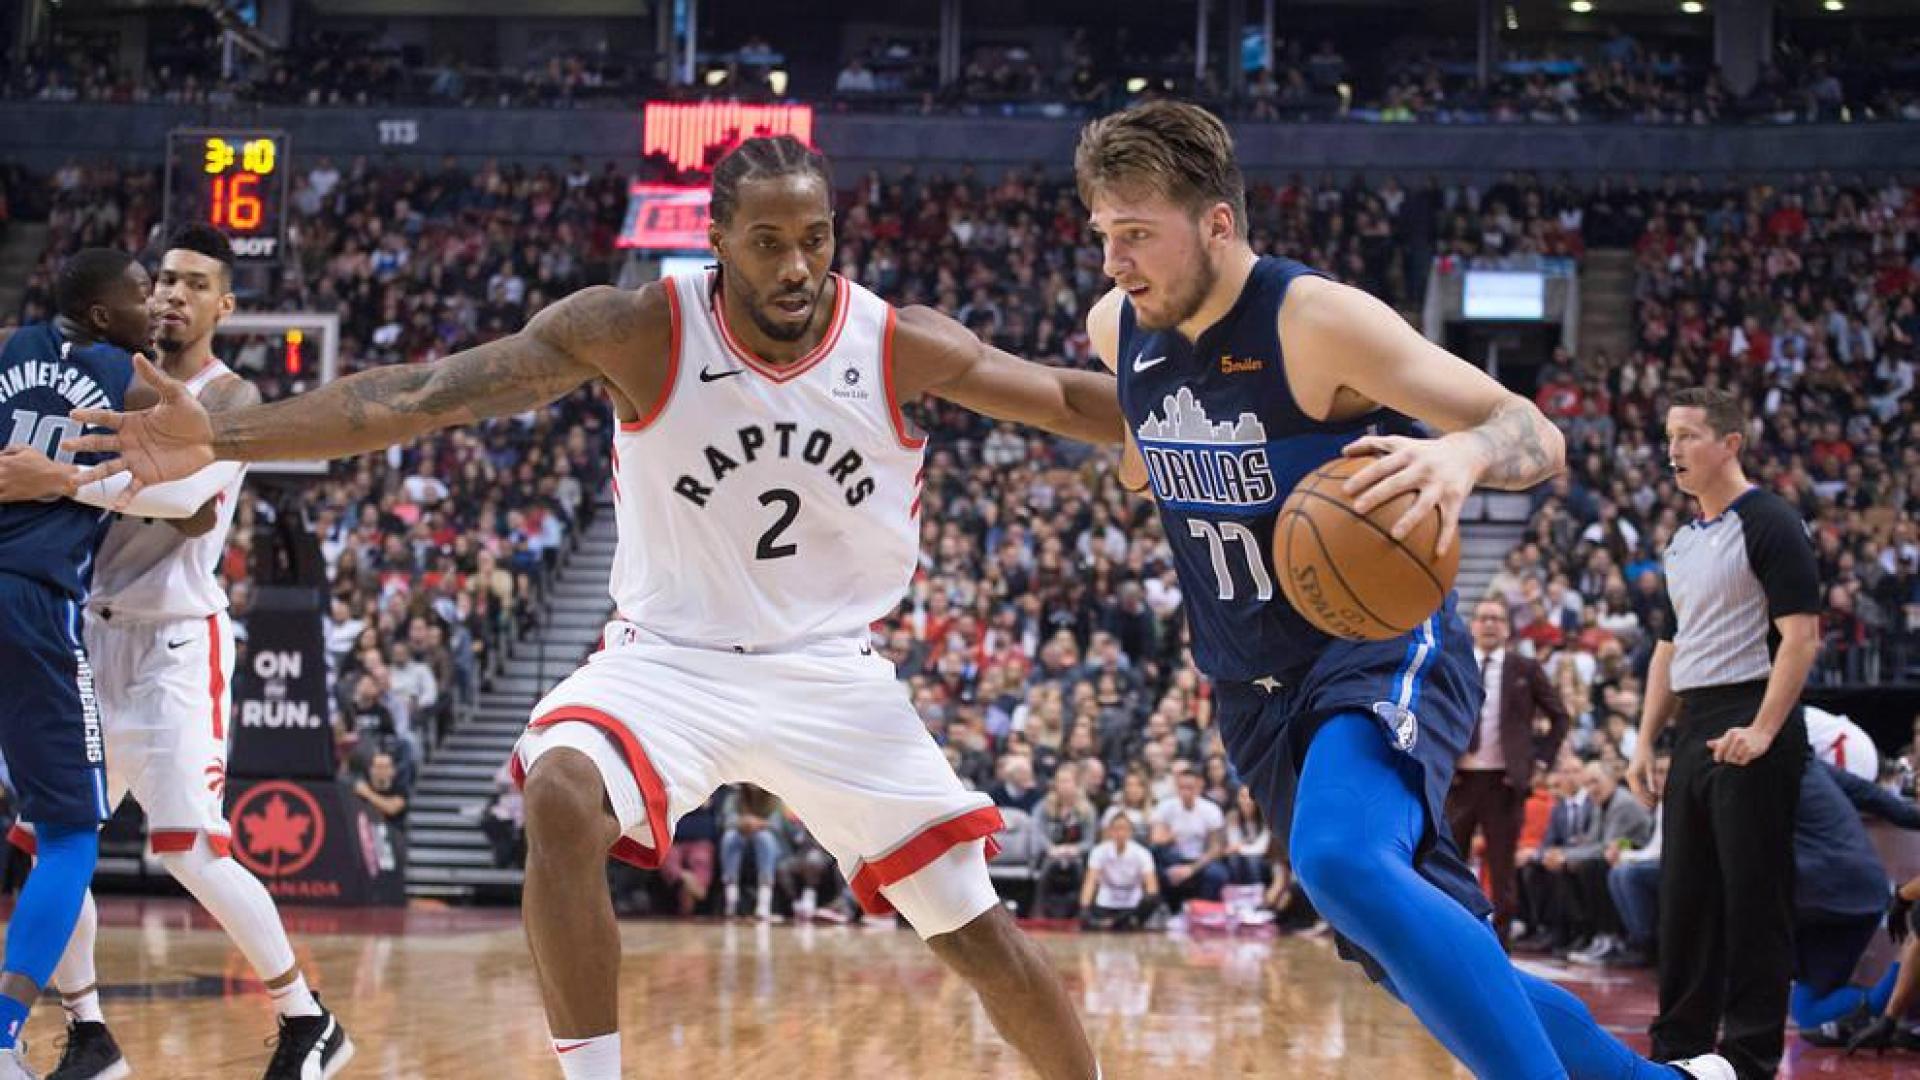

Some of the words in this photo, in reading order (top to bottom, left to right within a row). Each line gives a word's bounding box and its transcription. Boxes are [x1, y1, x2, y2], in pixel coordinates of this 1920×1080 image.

[211, 173, 261, 229] 16
[5, 408, 84, 465] 10
[674, 423, 876, 508] RAPTORS
[1144, 447, 1277, 506] DALLAS
[756, 488, 801, 560] 2
[1187, 519, 1273, 600] 77
[254, 651, 302, 679] ON
[242, 701, 321, 728] RUN.
[268, 881, 341, 896] ANADA
